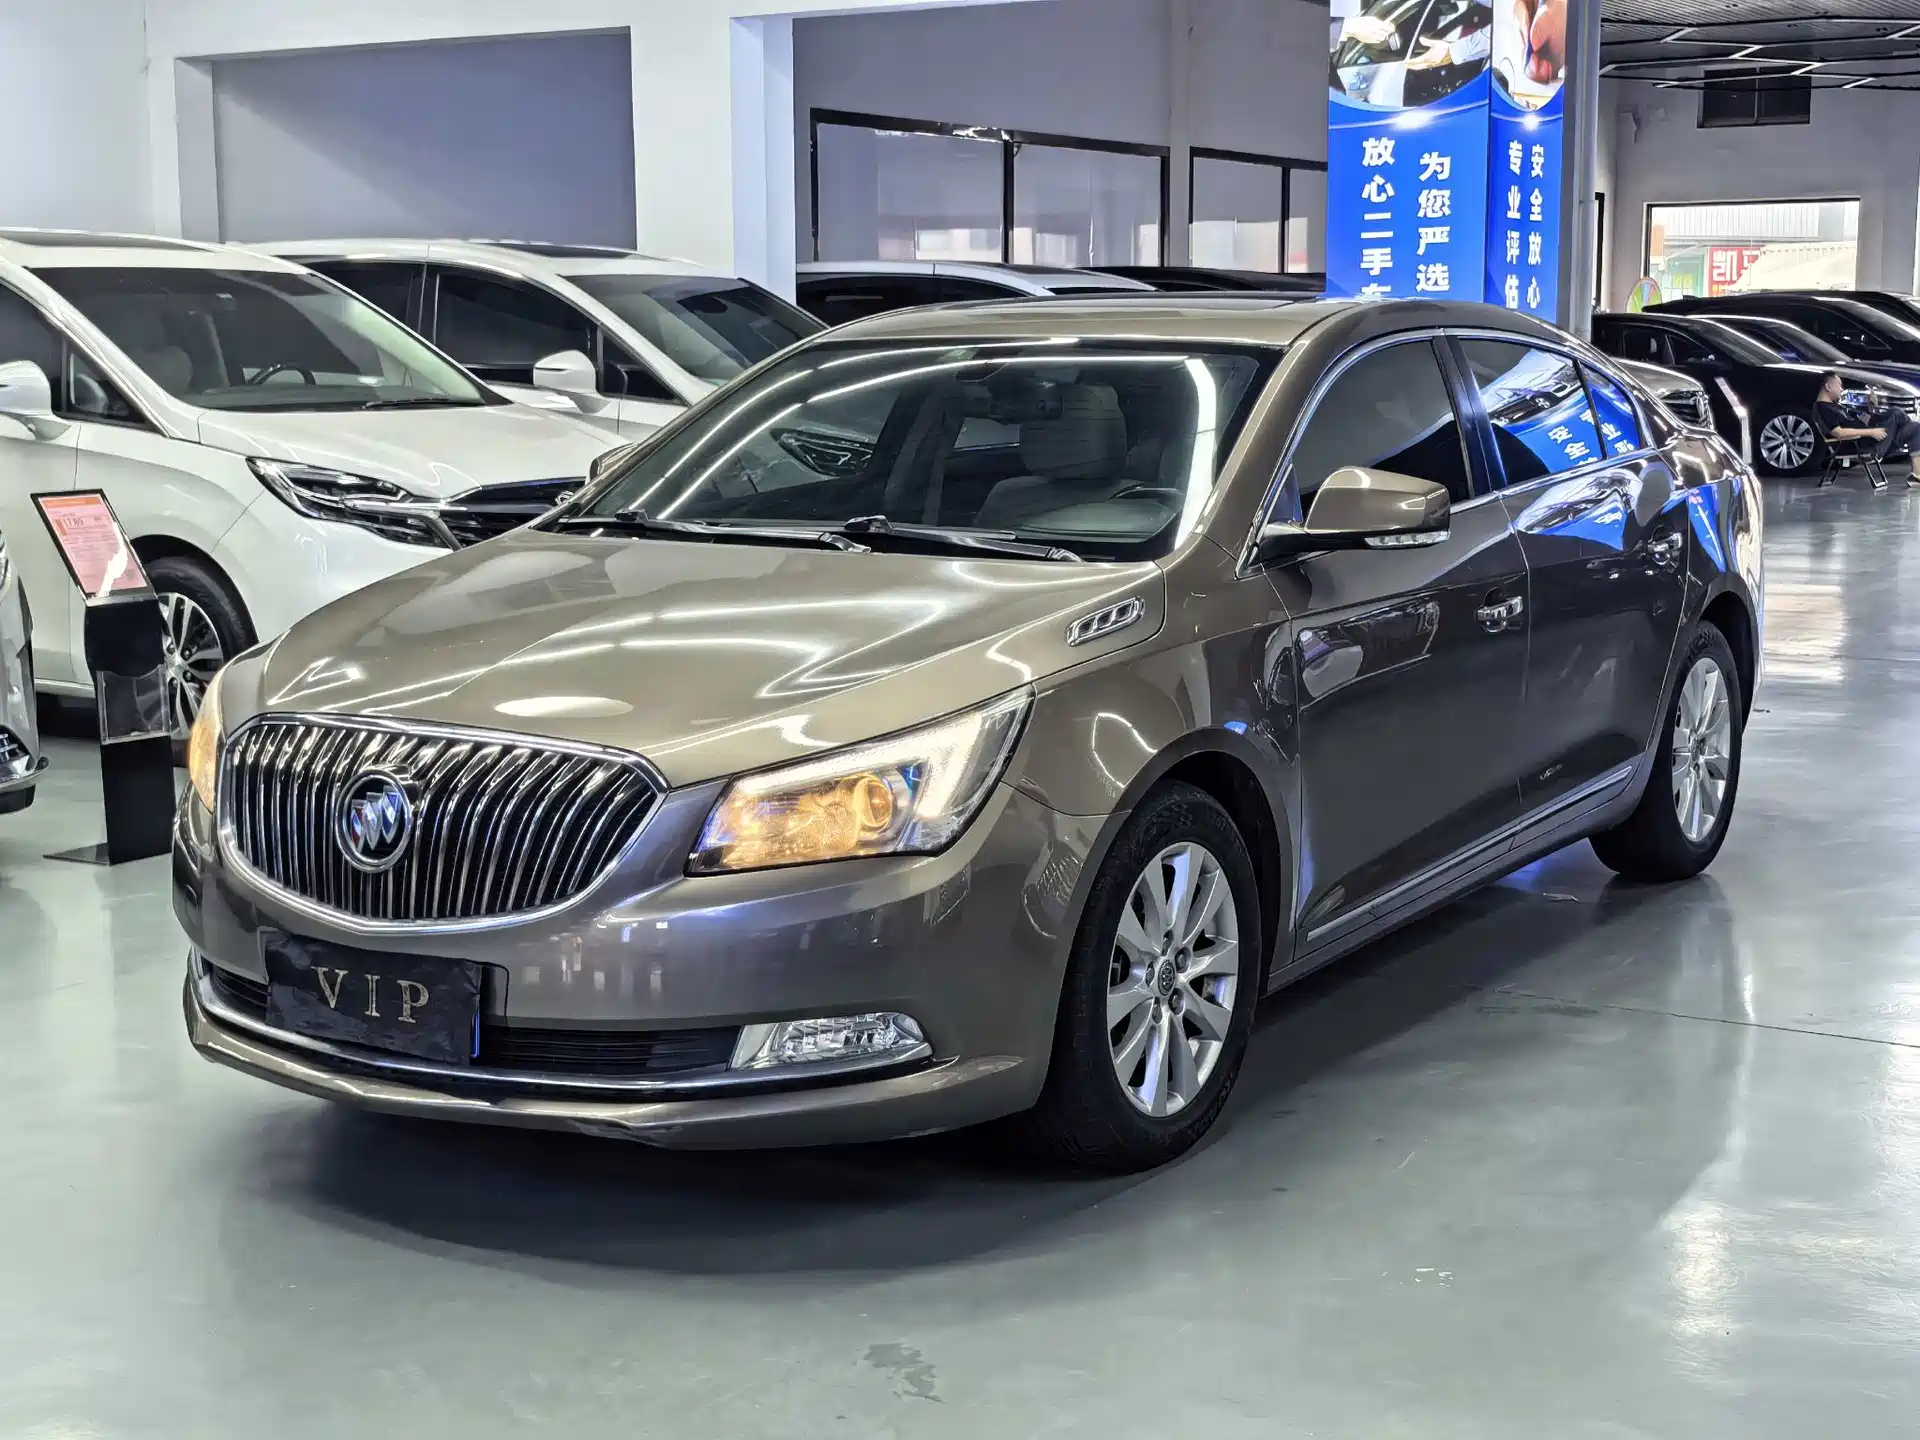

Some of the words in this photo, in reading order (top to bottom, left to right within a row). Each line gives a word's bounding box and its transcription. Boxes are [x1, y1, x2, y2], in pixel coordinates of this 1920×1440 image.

[1415, 151, 1451, 292] 为您严选
[1504, 139, 1523, 309] 专业评估
[1526, 143, 1545, 309] 安全放心
[310, 966, 430, 1024] VIP
